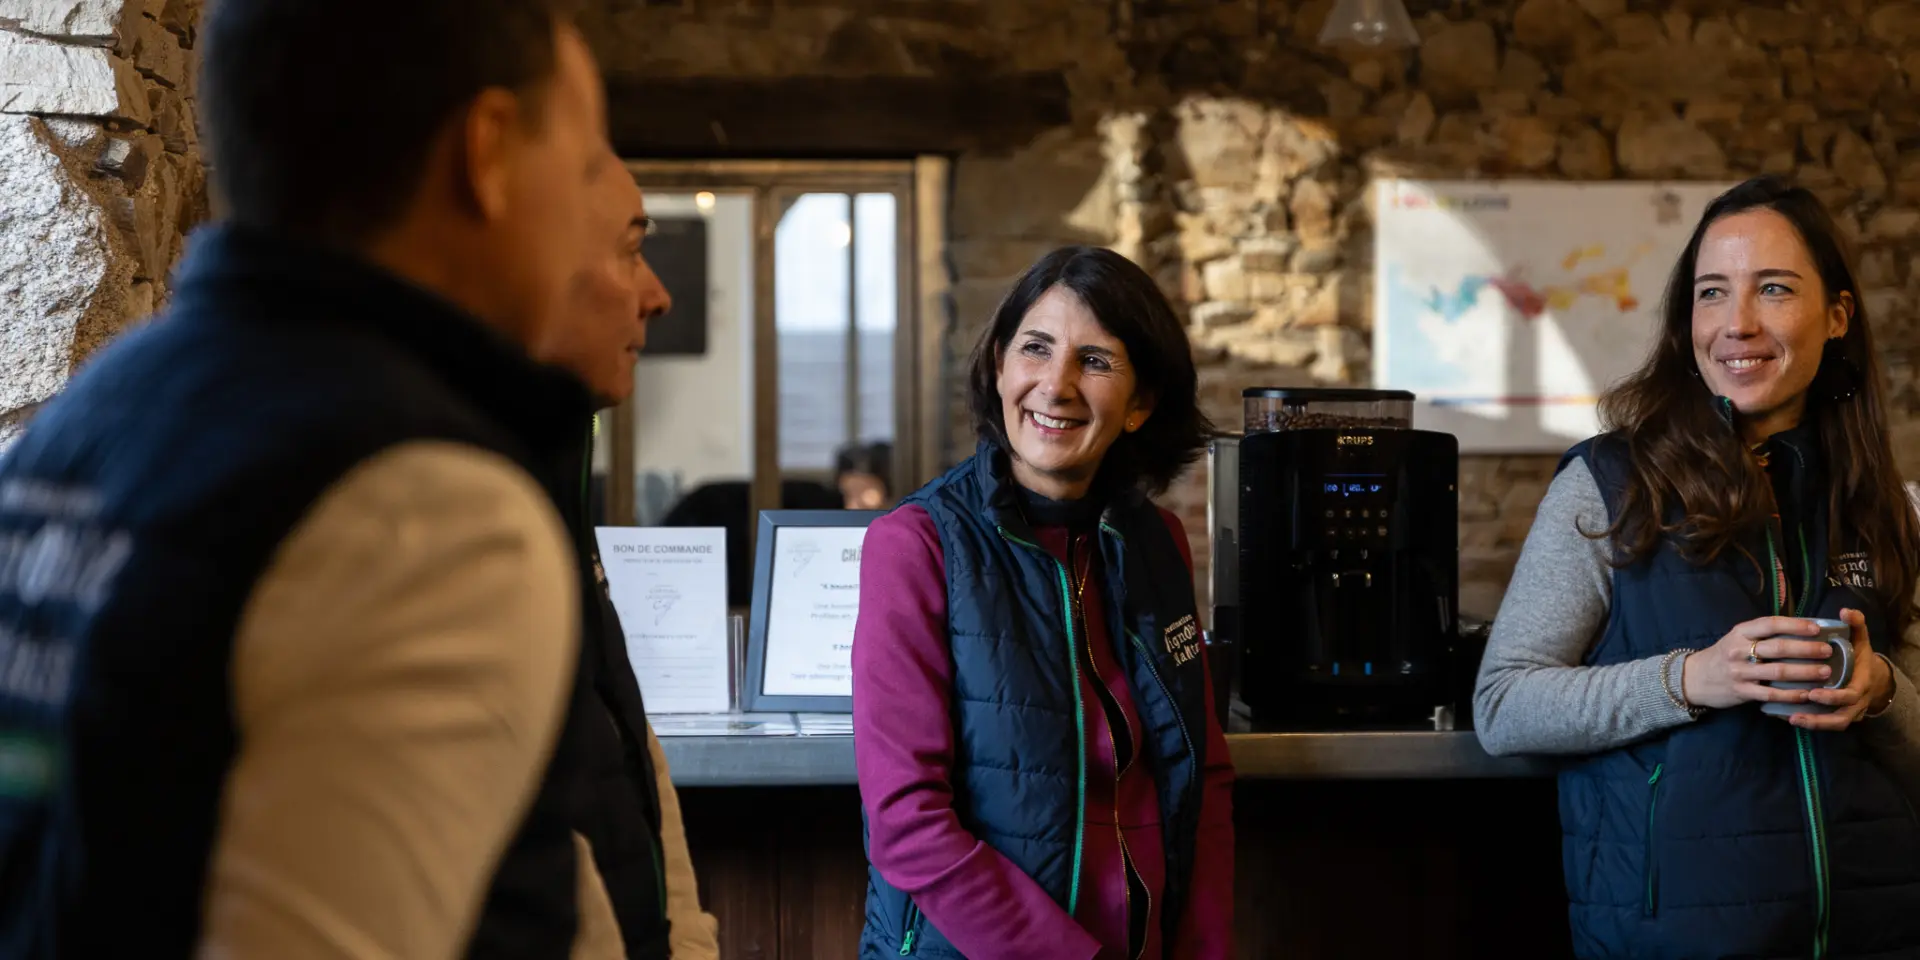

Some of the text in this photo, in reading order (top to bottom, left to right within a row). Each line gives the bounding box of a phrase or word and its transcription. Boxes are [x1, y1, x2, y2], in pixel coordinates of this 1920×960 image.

[1338, 435, 1374, 446] KRUPS
[613, 544, 713, 554] BON DE COMMANDE
